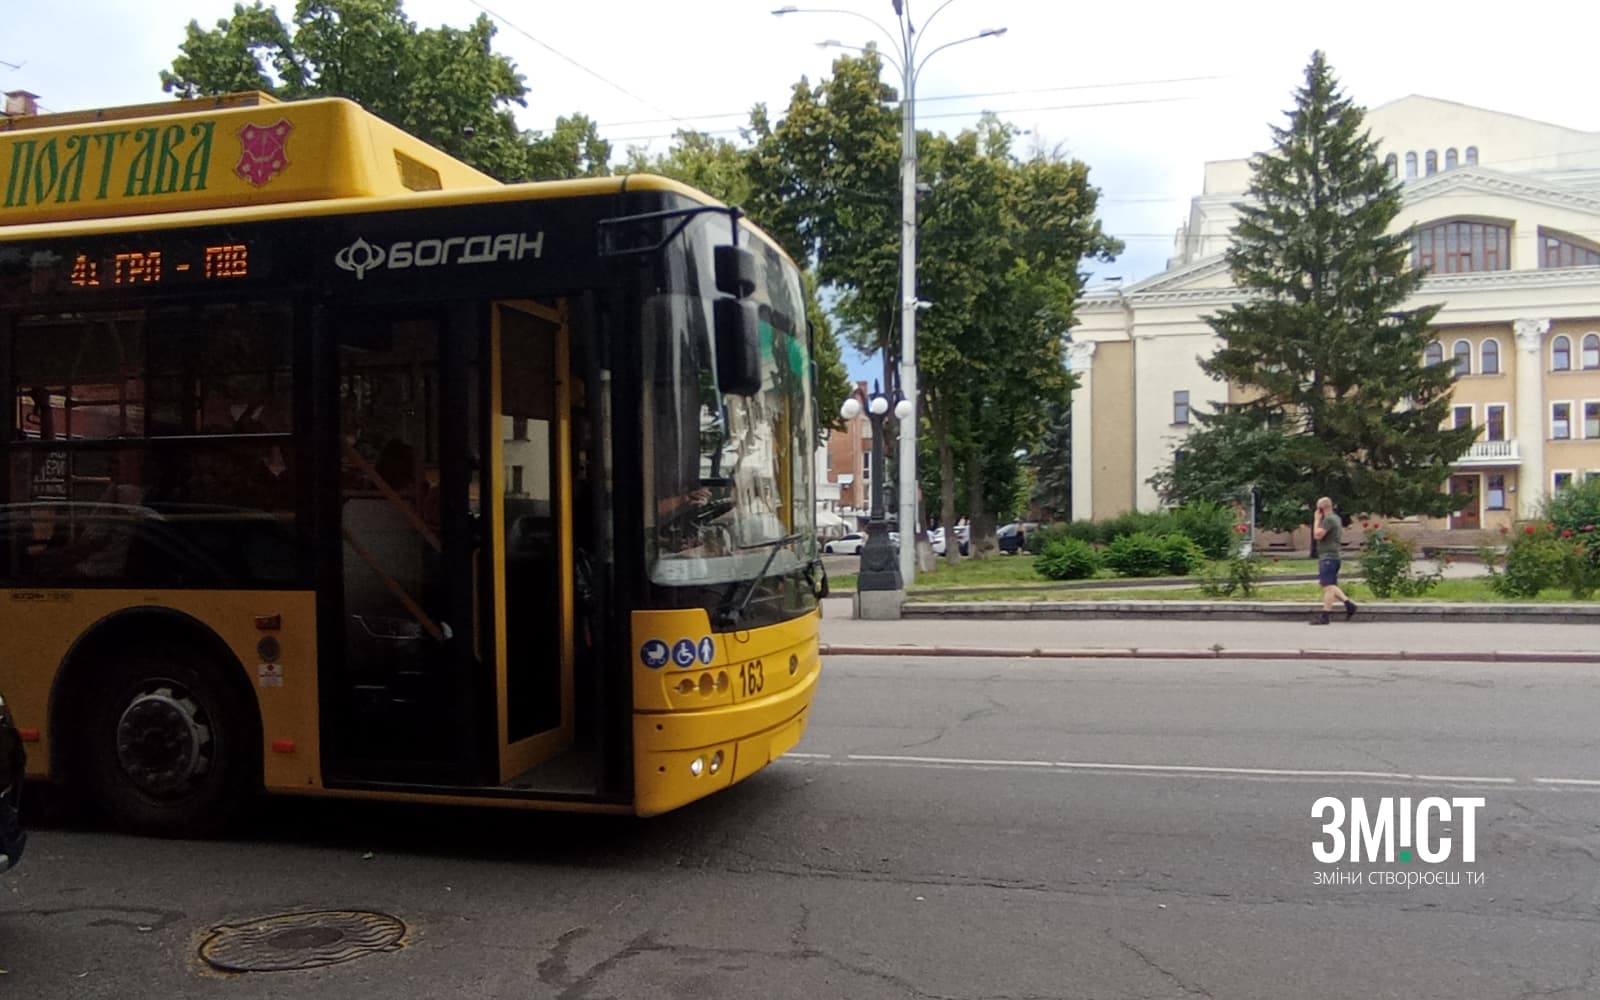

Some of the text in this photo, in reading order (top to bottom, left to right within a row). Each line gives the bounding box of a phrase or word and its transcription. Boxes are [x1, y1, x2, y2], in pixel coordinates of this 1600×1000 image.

[3, 121, 216, 208] ПОЛТАВА
[387, 231, 544, 269] БОГДАН
[740, 659, 764, 698] 163
